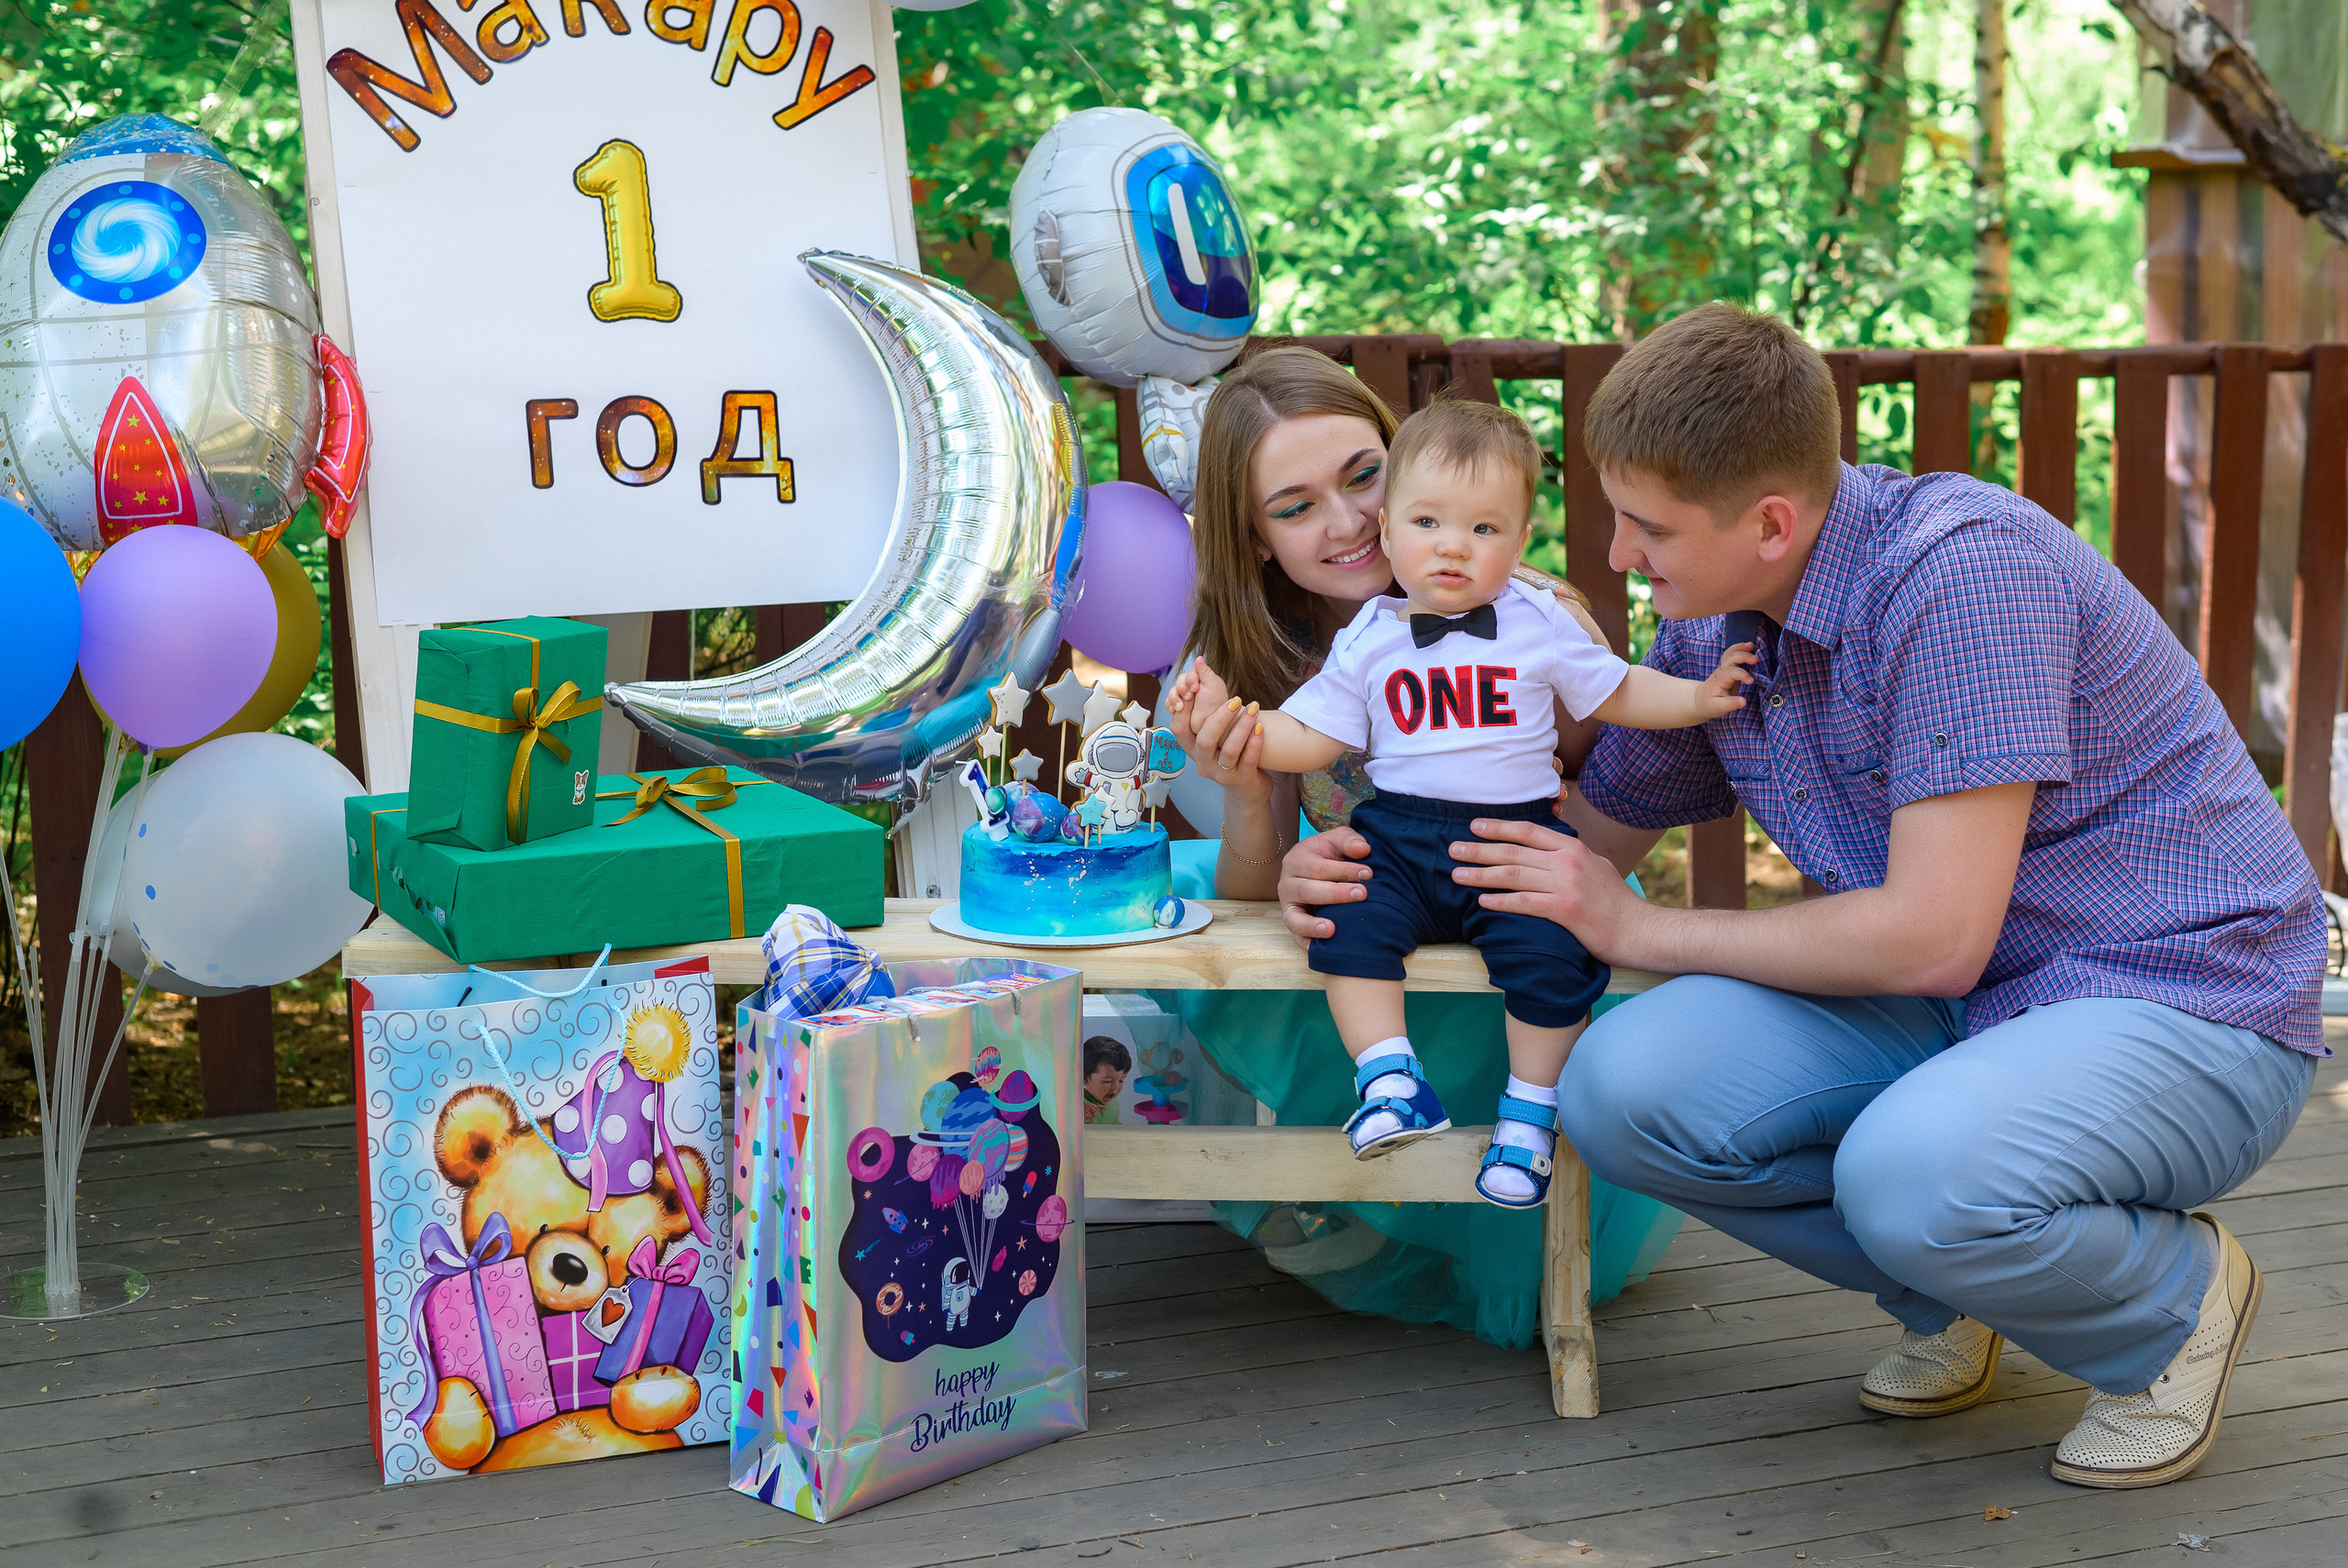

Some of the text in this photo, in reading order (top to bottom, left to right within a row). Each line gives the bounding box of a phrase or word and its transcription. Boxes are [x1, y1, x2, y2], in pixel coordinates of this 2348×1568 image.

[572, 138, 682, 323] 1
[1385, 665, 1517, 735] ONE
[936, 1361, 1000, 1397] happy
[910, 1396, 1017, 1452] Birthday
